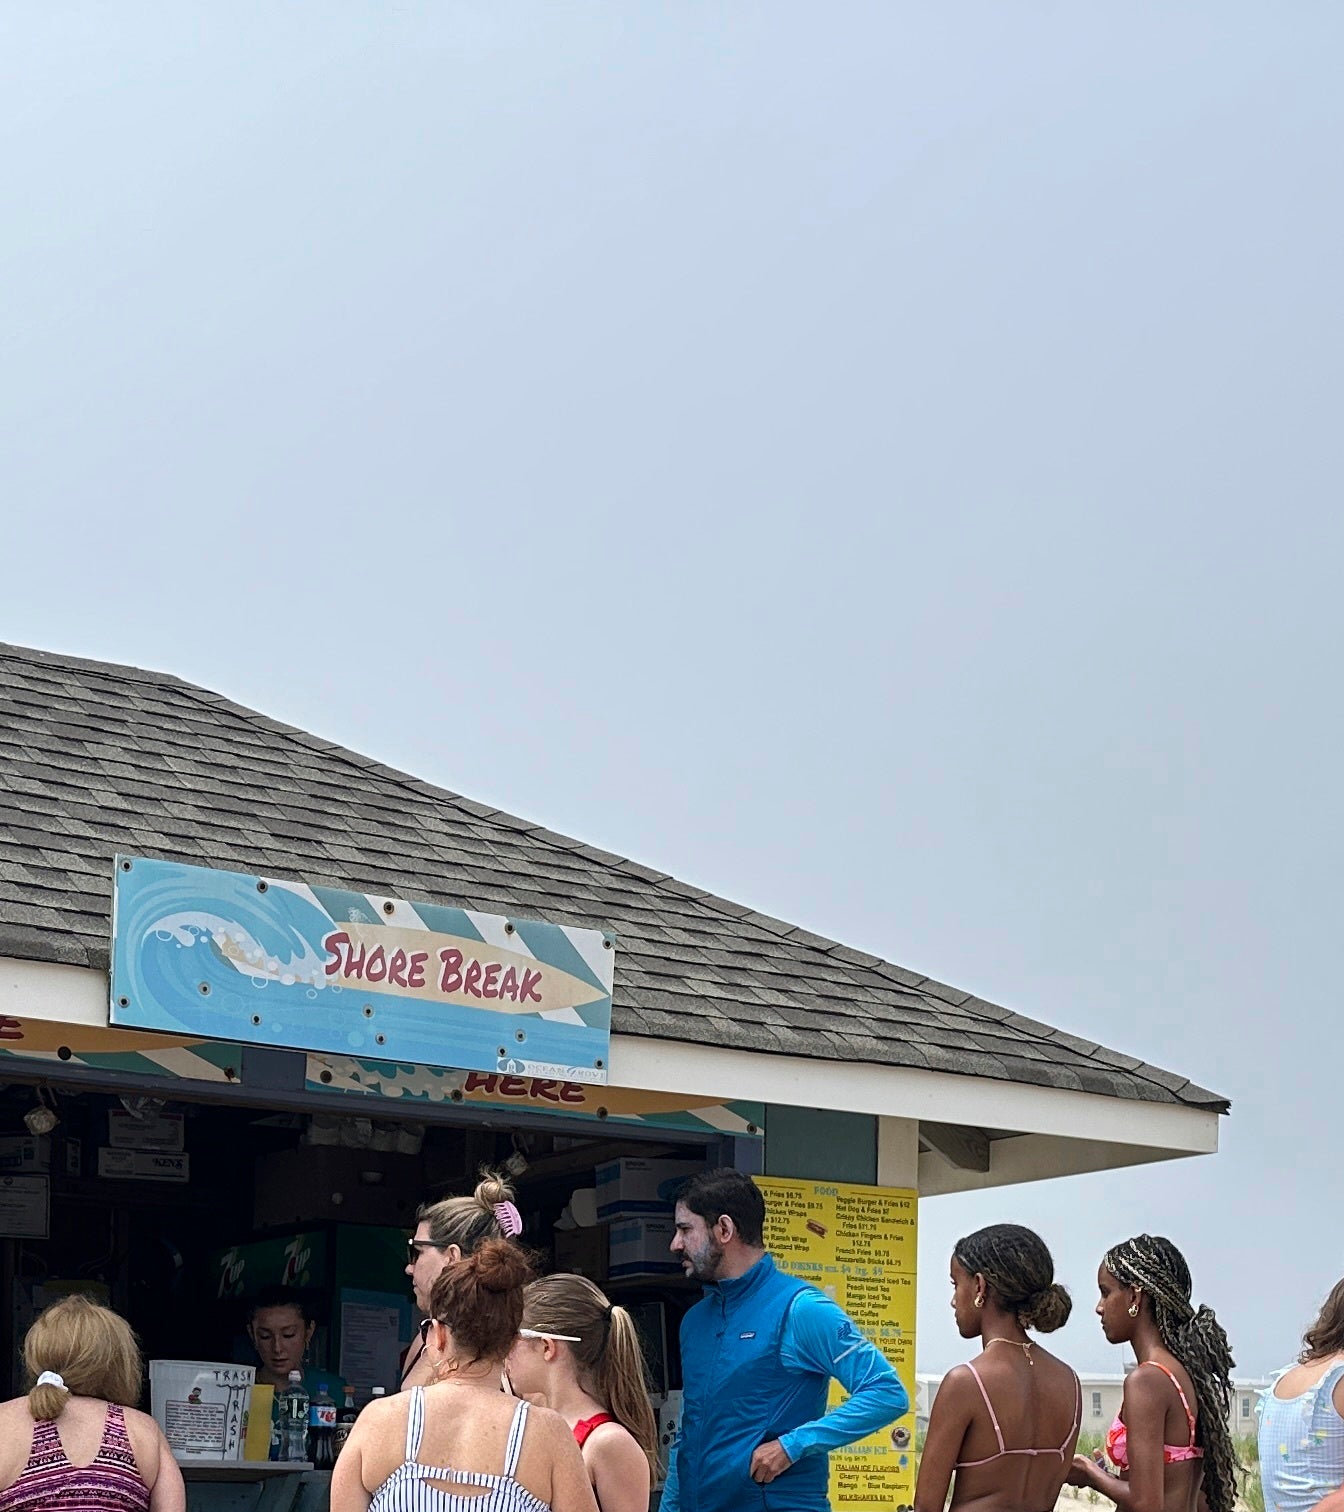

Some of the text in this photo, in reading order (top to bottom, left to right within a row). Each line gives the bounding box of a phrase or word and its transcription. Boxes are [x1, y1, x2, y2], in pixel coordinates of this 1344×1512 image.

[325, 932, 542, 1003] SHORE BREAK
[464, 1072, 586, 1102] HERE
[857, 1198, 877, 1207] Burger
